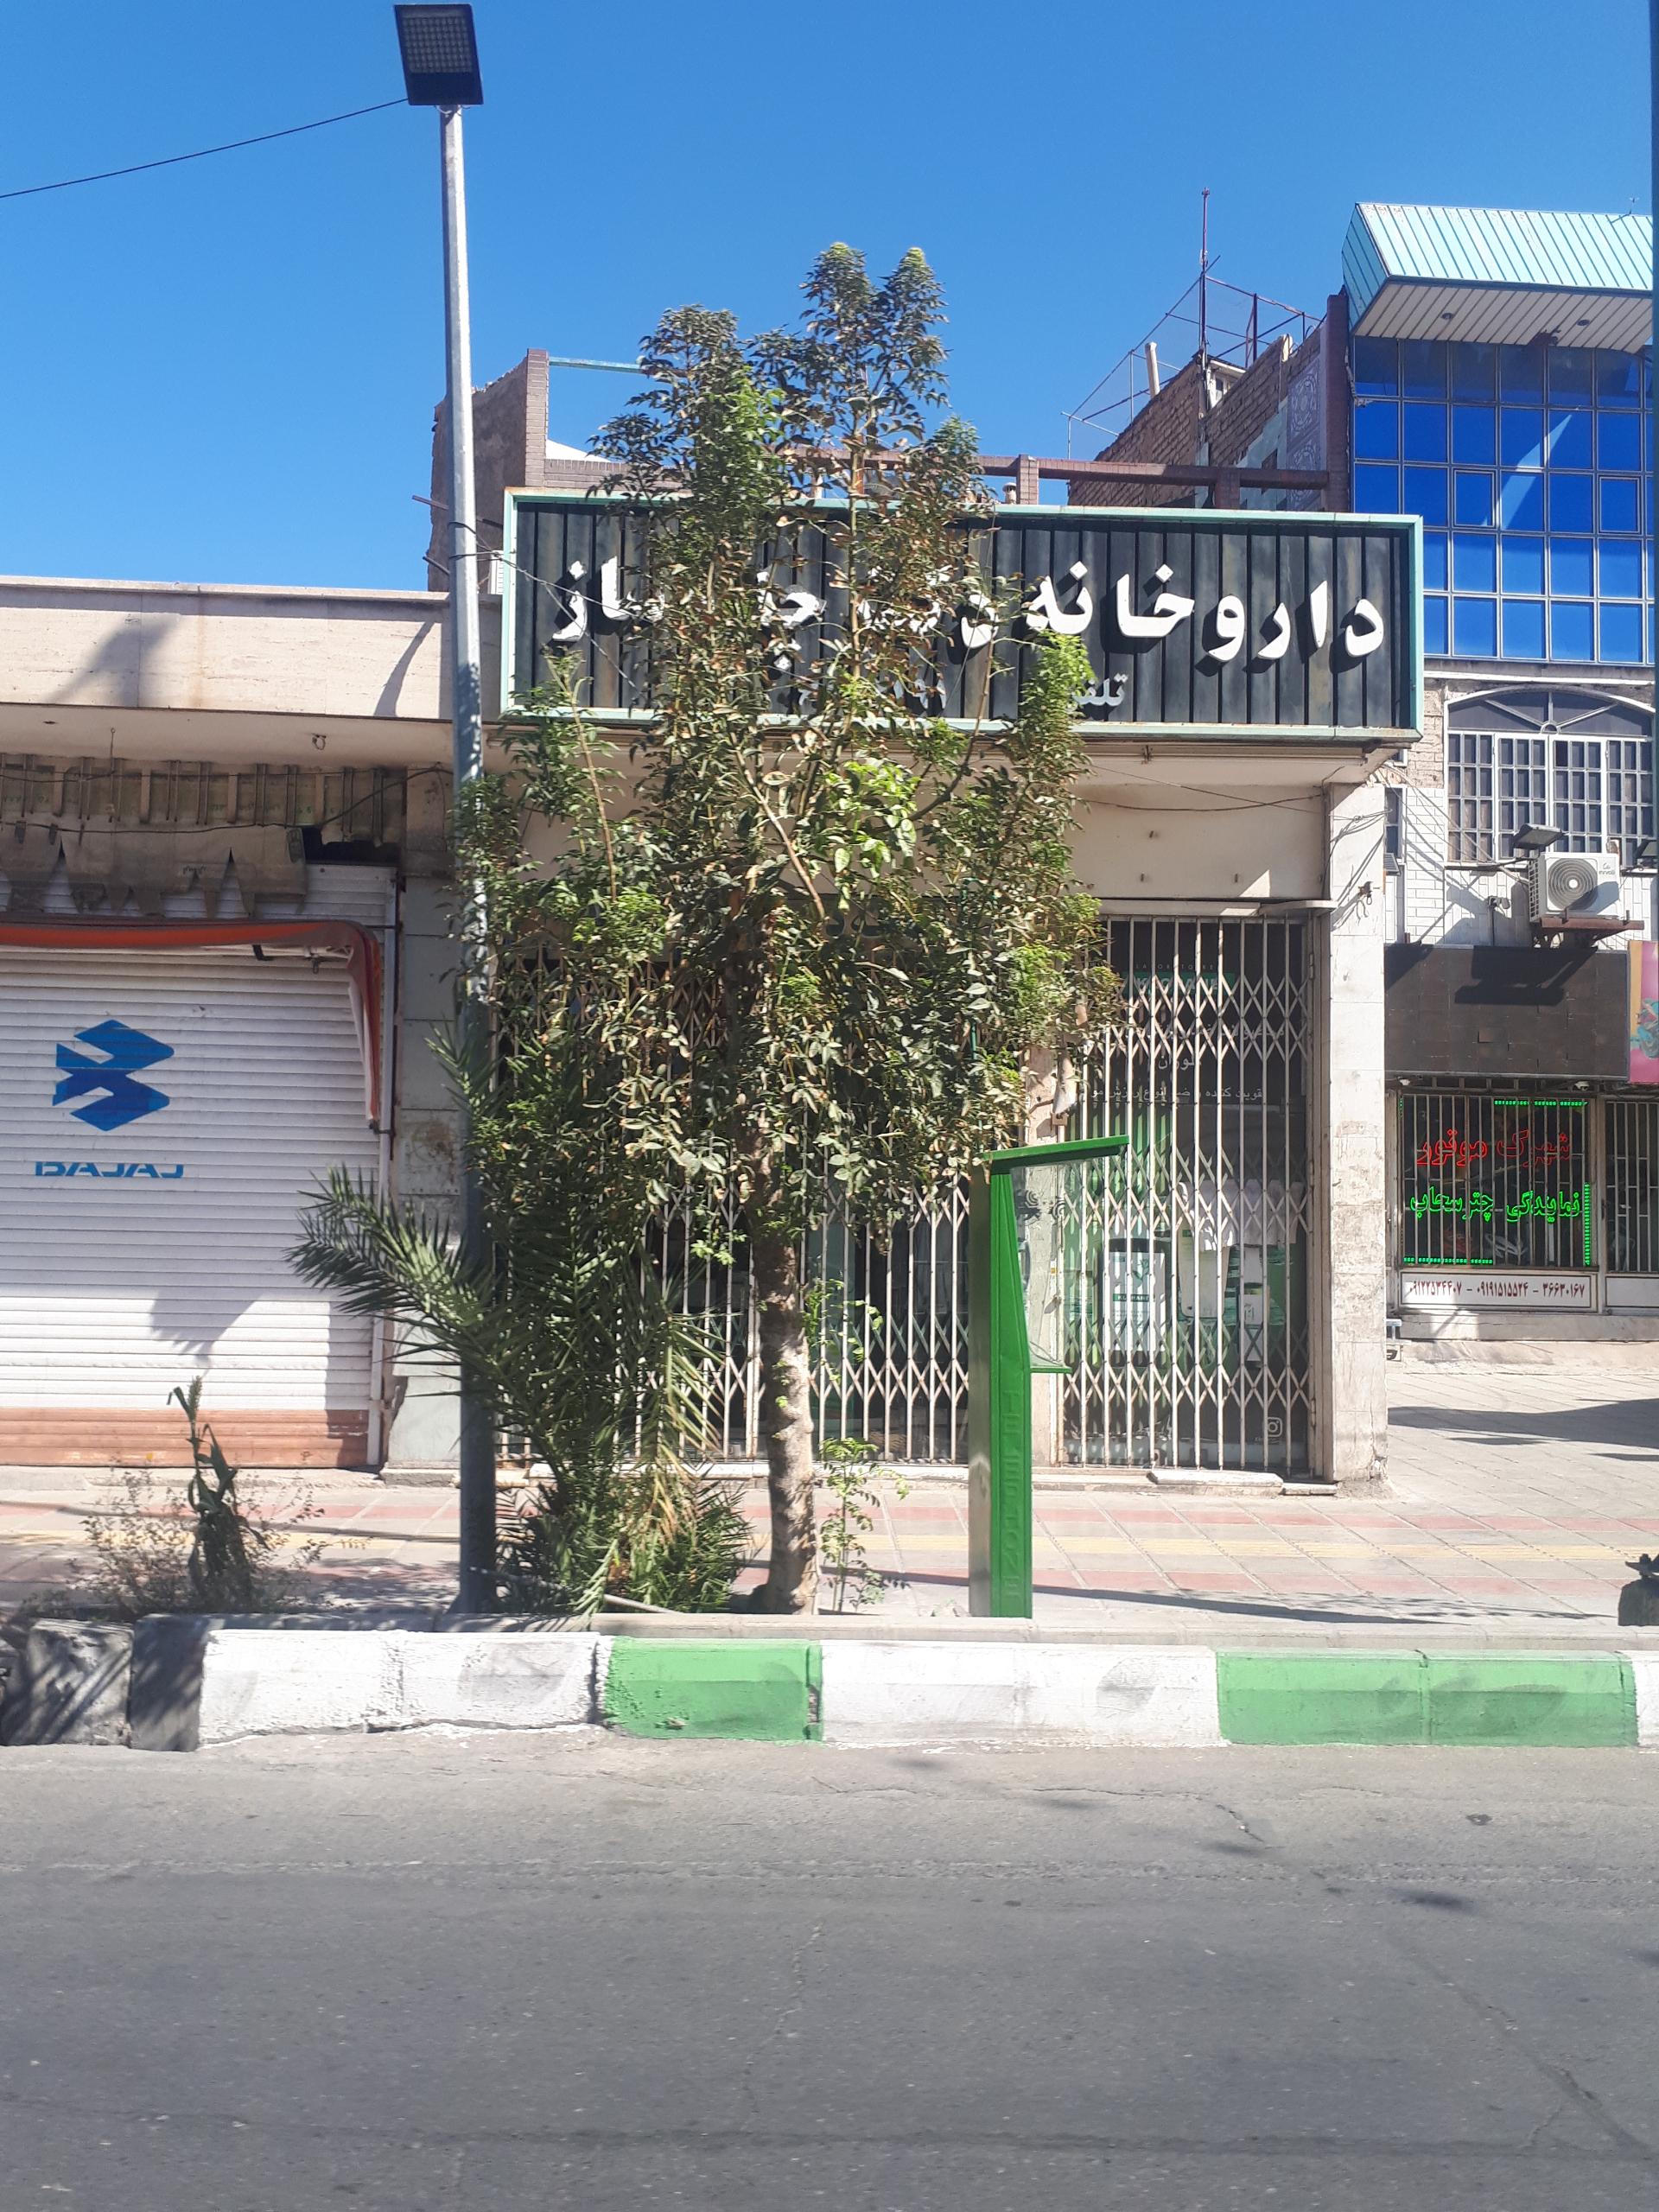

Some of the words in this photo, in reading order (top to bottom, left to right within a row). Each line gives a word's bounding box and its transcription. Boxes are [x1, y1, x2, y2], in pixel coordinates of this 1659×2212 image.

[1026, 561, 1384, 663] داروخانه
[1415, 1128, 1488, 1167] موتور
[1506, 1190, 1580, 1223] نمایندگی
